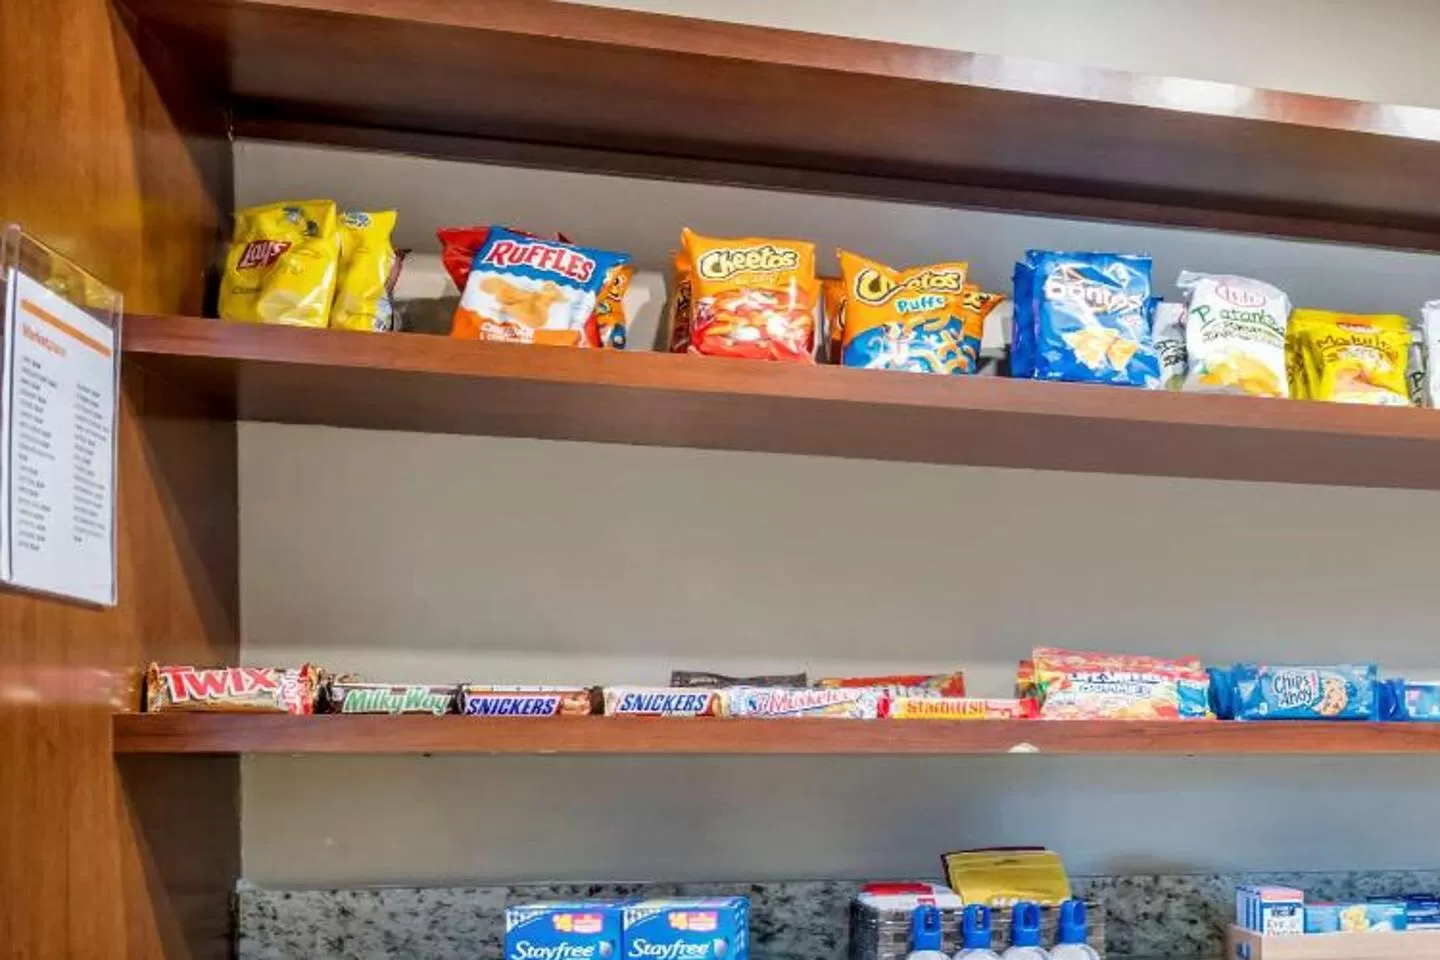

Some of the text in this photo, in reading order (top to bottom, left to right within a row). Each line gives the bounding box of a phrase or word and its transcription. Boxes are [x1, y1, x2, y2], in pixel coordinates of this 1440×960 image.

[484, 239, 596, 283] RUFFLES
[700, 247, 798, 279] Cheetos
[160, 666, 277, 703] TWIX
[344, 687, 450, 715] Milky Way
[467, 697, 557, 714] SNICKERS
[620, 693, 708, 712] SNICKERS
[630, 938, 710, 960] Stayfree
